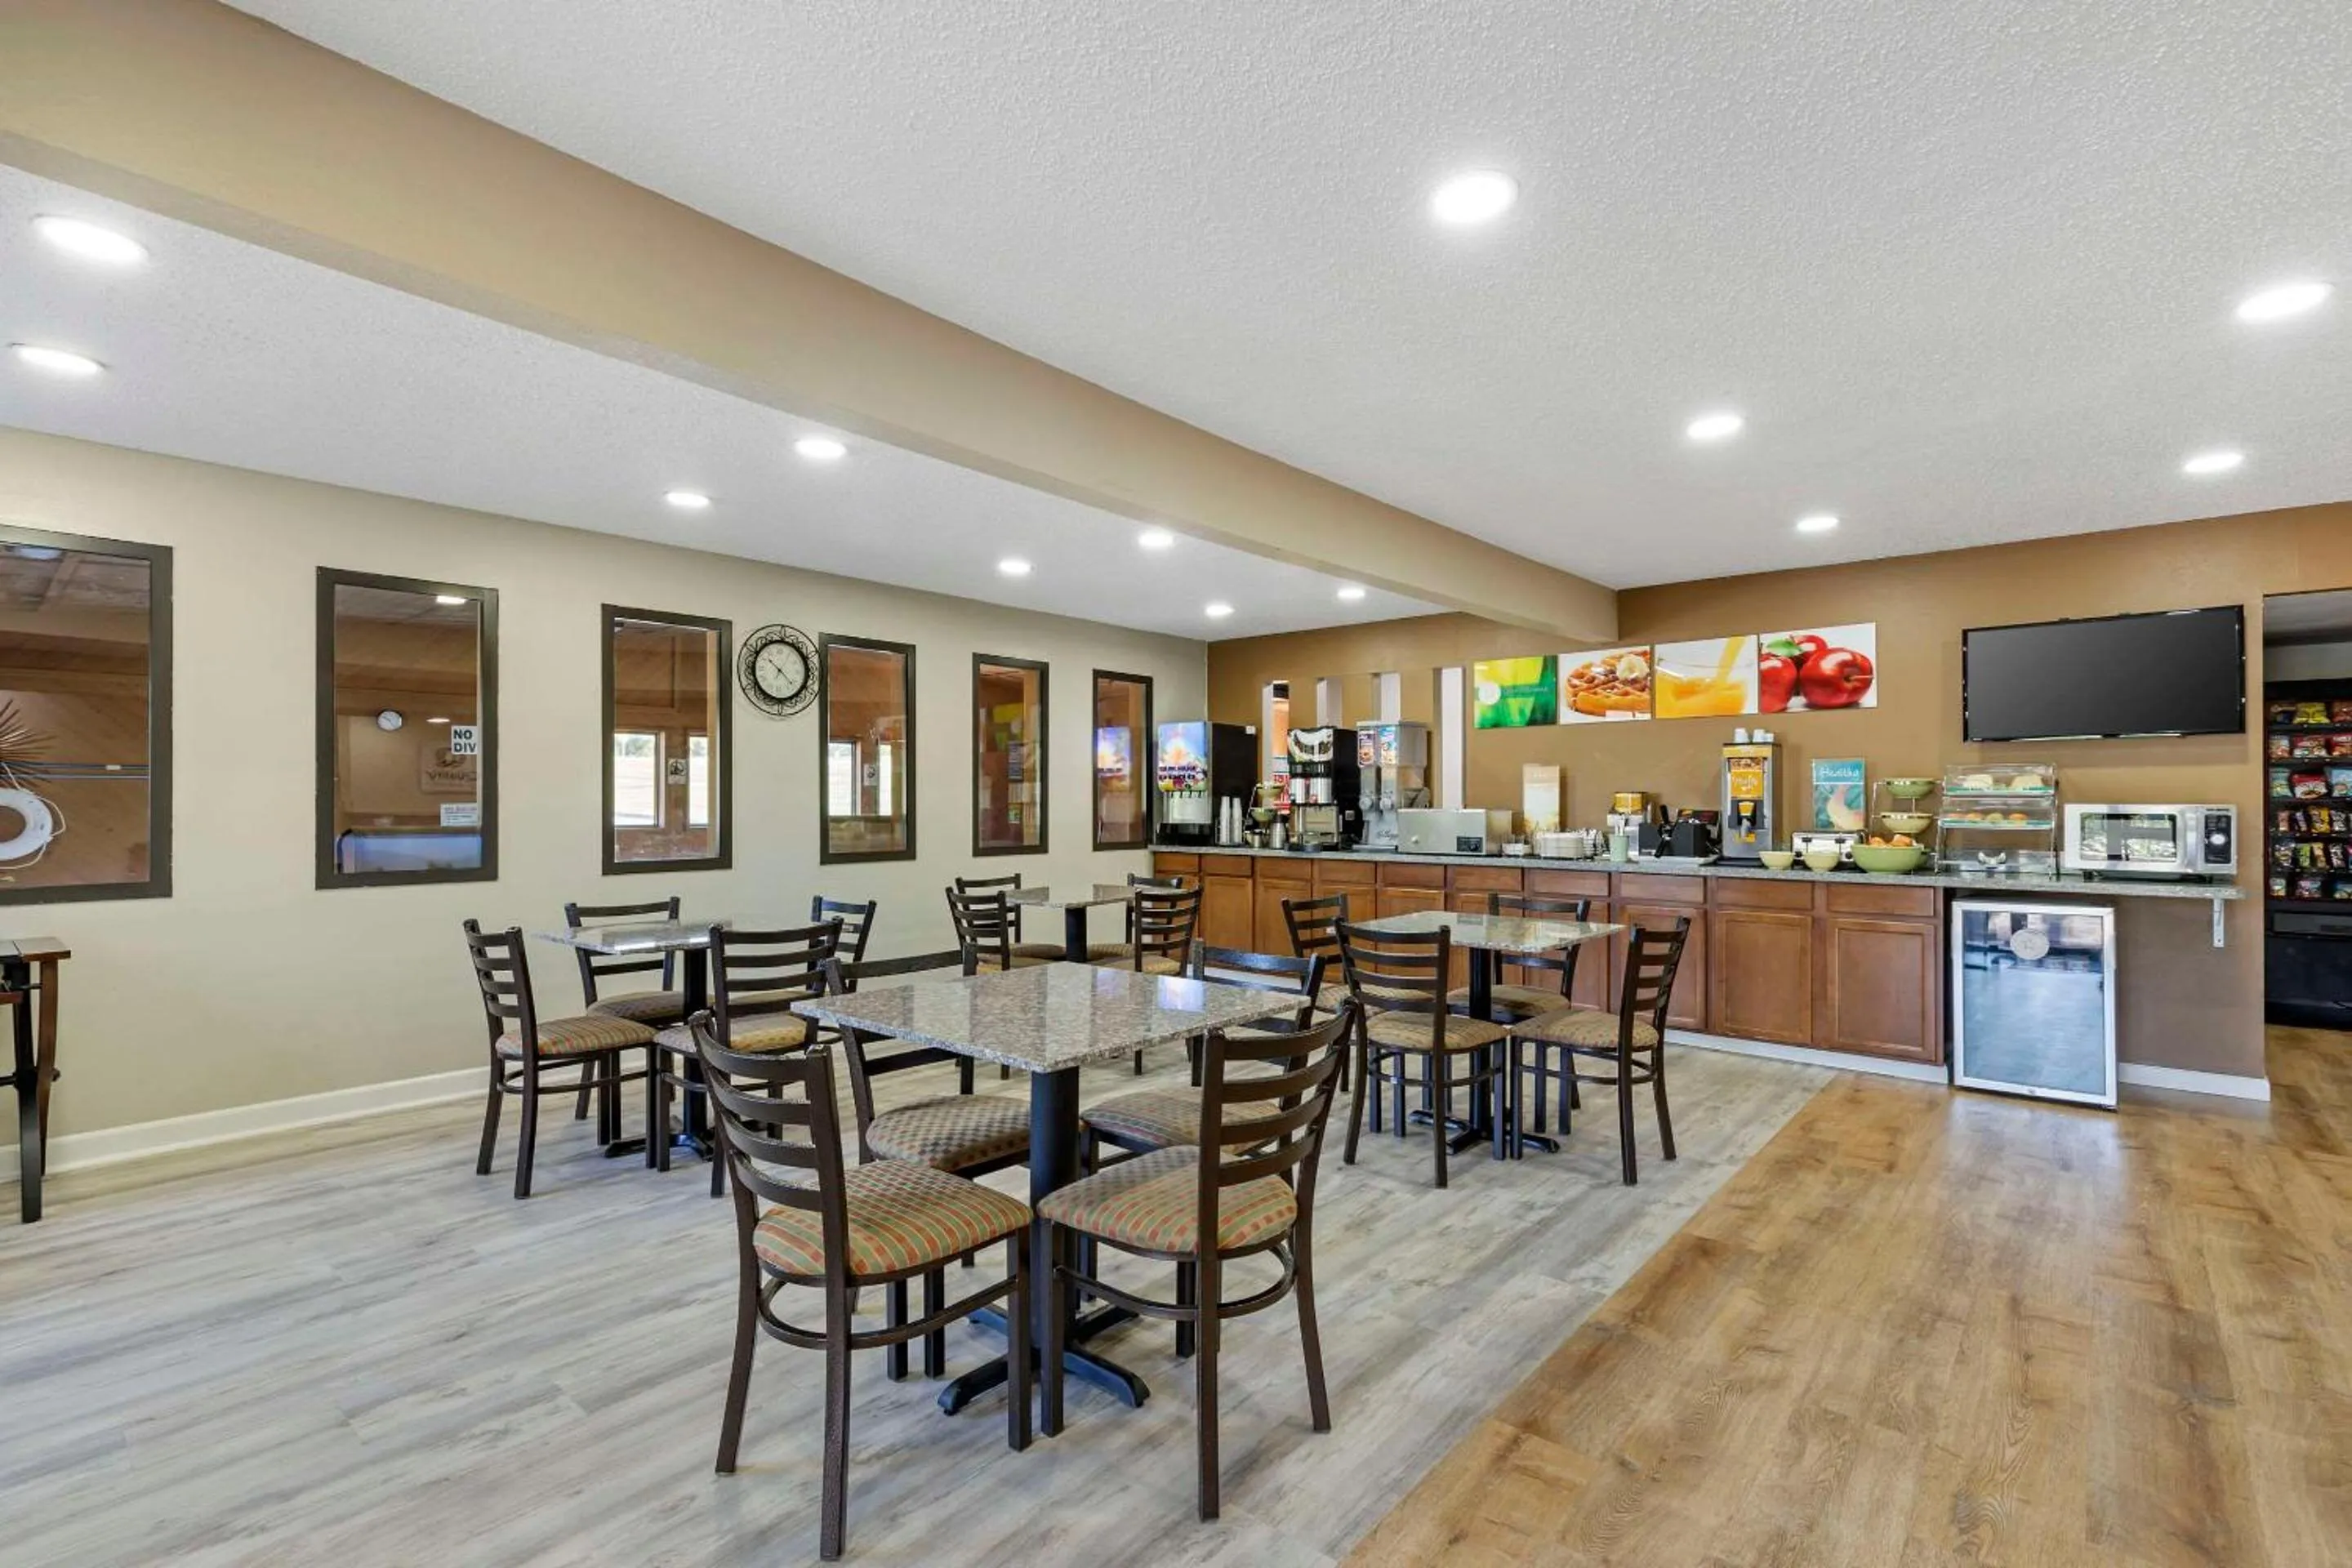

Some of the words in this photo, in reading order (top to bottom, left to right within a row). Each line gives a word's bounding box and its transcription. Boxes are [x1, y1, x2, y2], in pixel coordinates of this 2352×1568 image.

[454, 729, 473, 740] NO
[454, 742, 476, 753] DIV
[1819, 765, 1860, 782] Healthy
